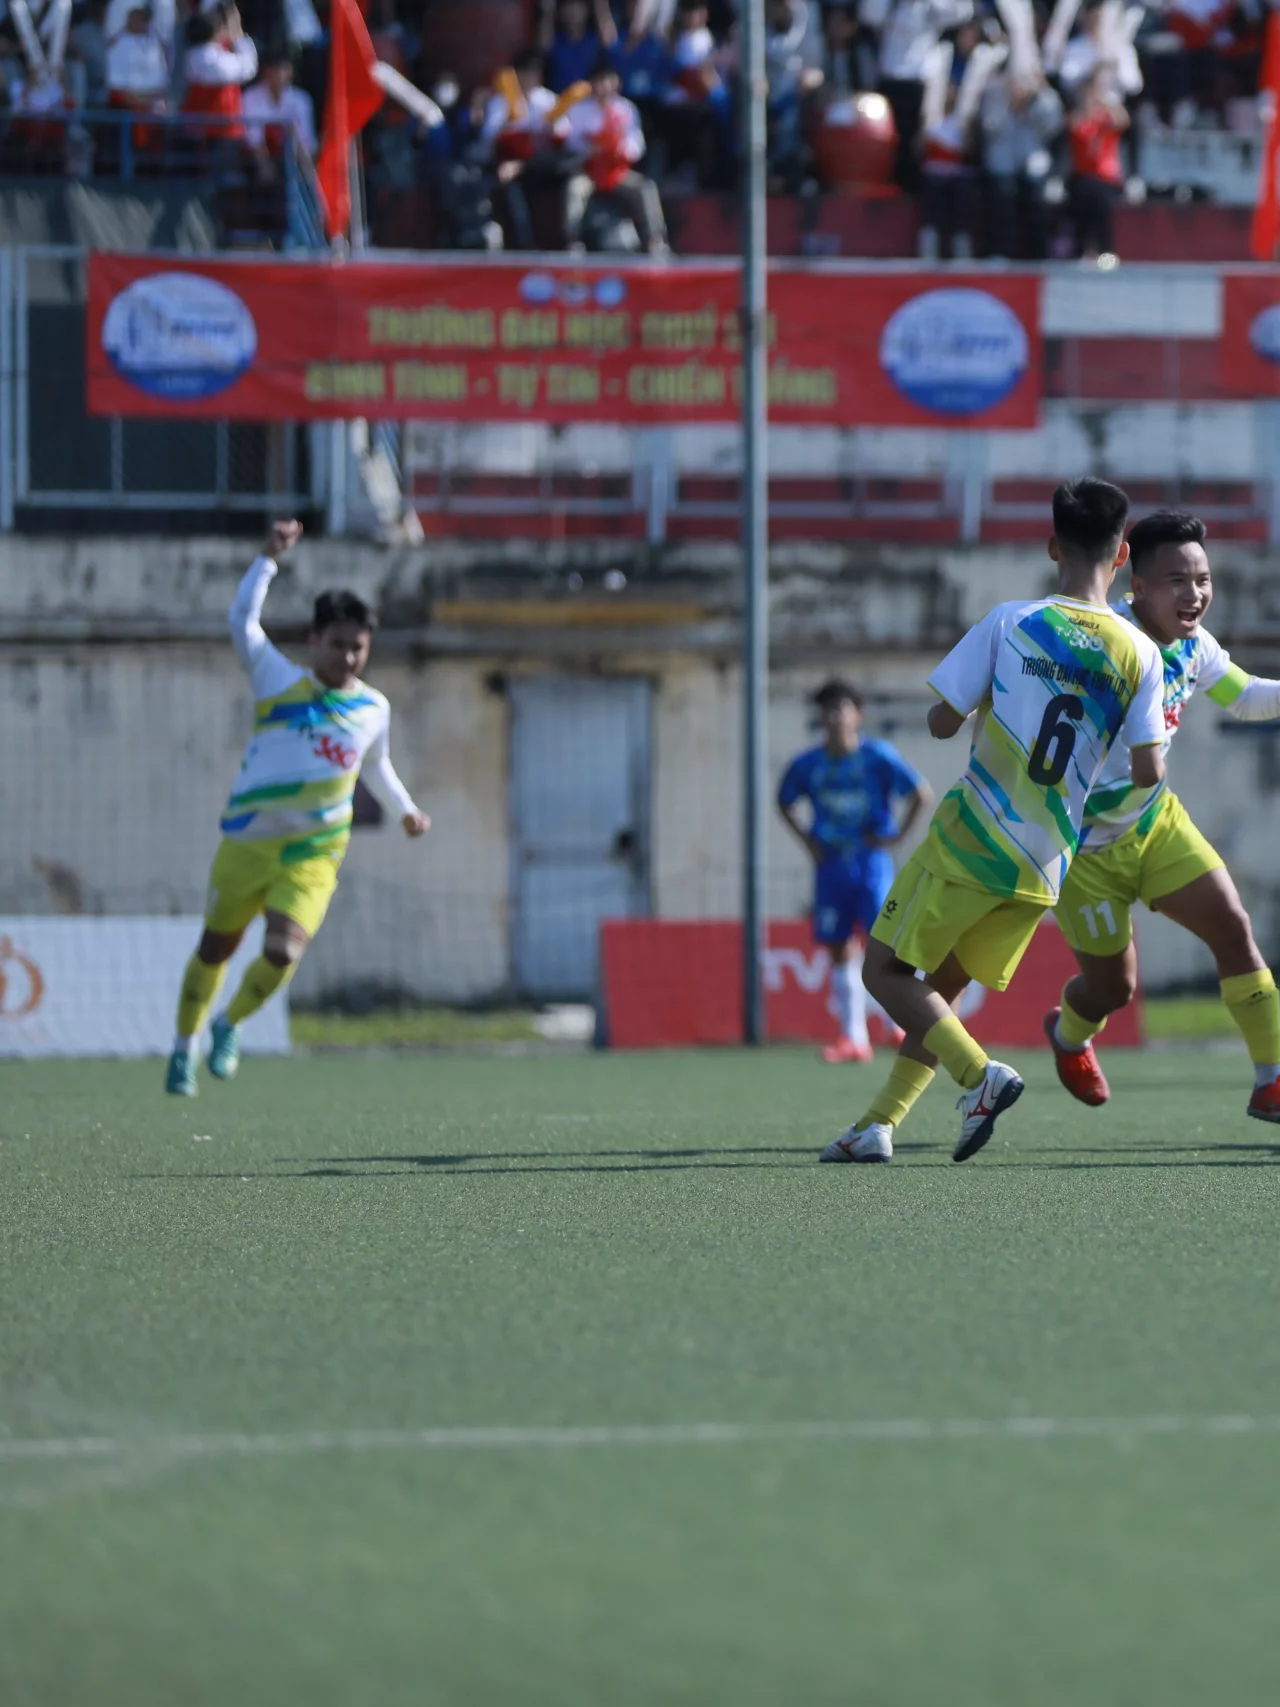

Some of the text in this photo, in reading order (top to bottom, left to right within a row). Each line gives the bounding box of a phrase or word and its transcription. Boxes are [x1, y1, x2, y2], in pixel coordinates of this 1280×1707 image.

[1021, 655, 1056, 679] TRƯỜNG
[1028, 694, 1084, 786] 6
[1078, 900, 1117, 939] 11
